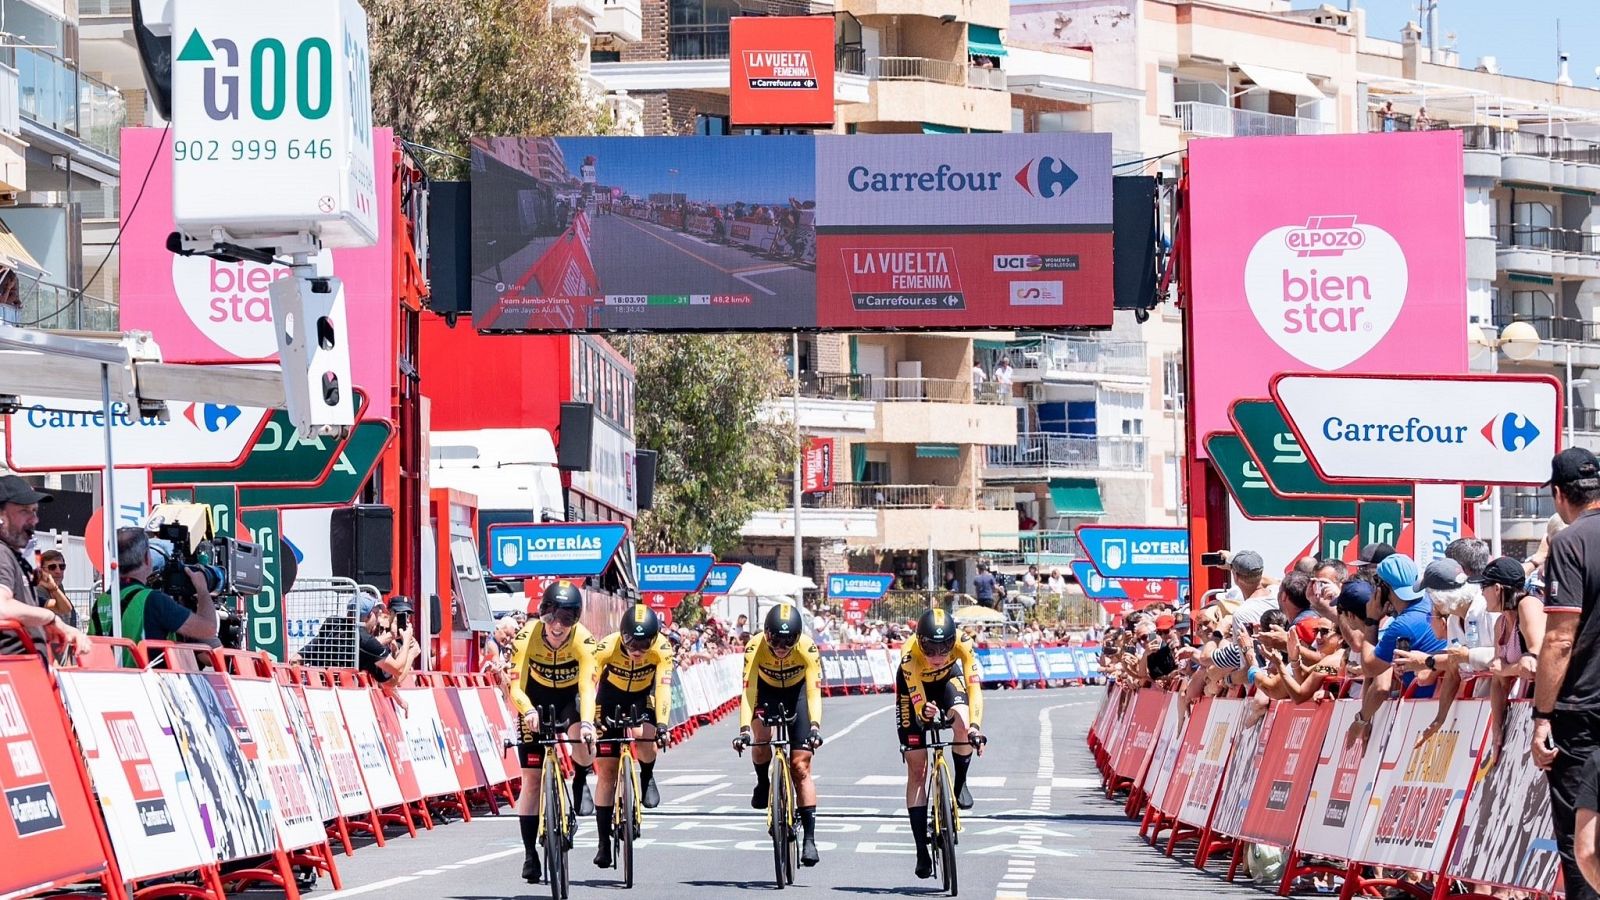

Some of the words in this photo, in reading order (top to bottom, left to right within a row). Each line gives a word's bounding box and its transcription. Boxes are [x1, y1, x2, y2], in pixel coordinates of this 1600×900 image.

[749, 53, 763, 67] LA
[765, 53, 808, 67] VUELTA
[757, 79, 801, 87] Carrefour.es
[174, 140, 219, 161] 902
[231, 140, 277, 160] 999
[287, 139, 332, 160] 646
[848, 164, 1002, 192] Carrefour
[853, 253, 876, 274] LA
[879, 252, 949, 274] VUELTA
[997, 257, 1024, 269] UCI
[892, 275, 952, 289] FEMENINA
[1282, 269, 1372, 302] bien
[521, 296, 570, 304] Jumbo-Visma
[613, 296, 646, 304] 18:03.90
[731, 295, 751, 303] km/h
[866, 296, 937, 306] Carrefour.es
[1283, 303, 1364, 334] star
[1323, 416, 1468, 444] Carrefour
[527, 534, 602, 550] LOTERÍAS
[644, 563, 695, 574] LOTERÍAS
[900, 694, 911, 728] JUMBO
